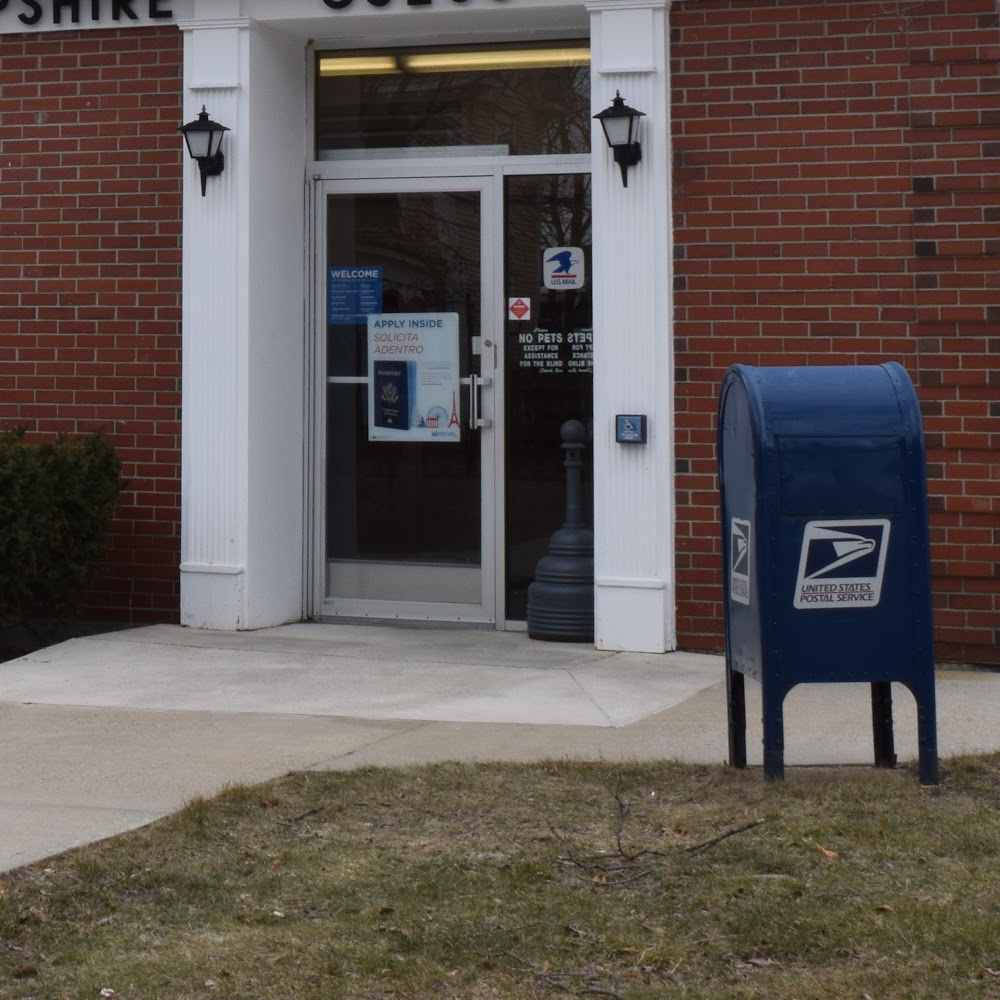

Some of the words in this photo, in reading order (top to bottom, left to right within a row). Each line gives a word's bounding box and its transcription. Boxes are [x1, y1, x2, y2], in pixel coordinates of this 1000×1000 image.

[331, 270, 379, 278] WELCOME
[374, 320, 405, 328] APPLY
[408, 320, 443, 328] INSIDE
[374, 333, 418, 342] SOLICITA
[518, 333, 533, 343] NO
[537, 333, 563, 343] PETS
[374, 345, 424, 354] ADENTRO
[801, 583, 837, 592] UNITED
[838, 582, 871, 592] STATES
[800, 594, 835, 603] POSTAL
[836, 593, 874, 602] SERVICE
